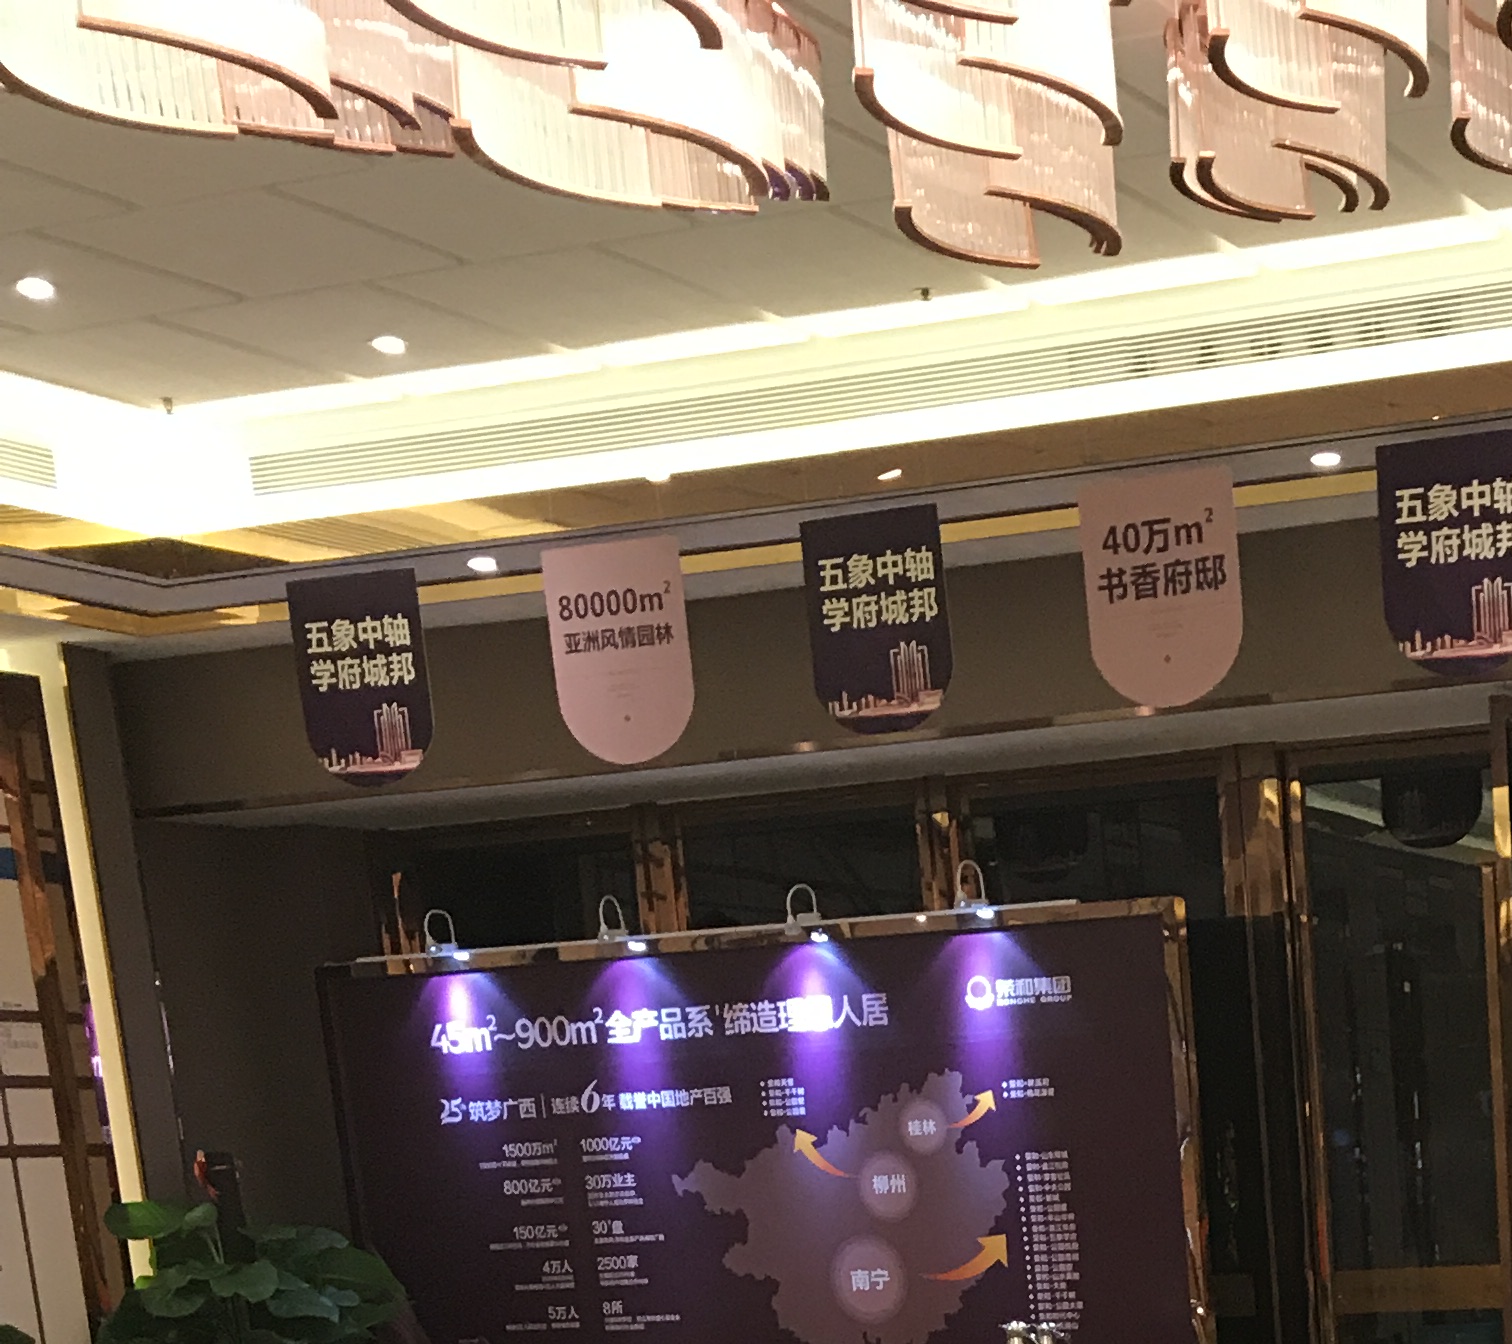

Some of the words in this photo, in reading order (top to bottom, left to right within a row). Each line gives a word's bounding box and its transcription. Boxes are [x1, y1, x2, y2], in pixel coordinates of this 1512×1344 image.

[818, 546, 934, 591] 五象中轴
[1098, 554, 1226, 603] 书香府邸
[822, 585, 938, 631] 学府城邦
[305, 613, 410, 655] 五象中轴
[564, 621, 674, 655] 亚洲风情园林
[310, 653, 416, 692] 学府城邦
[724, 994, 889, 1038] 缔造理人居
[908, 1118, 937, 1137] 桂林
[872, 1174, 907, 1195] 柳州
[850, 1268, 891, 1292] 南宁
